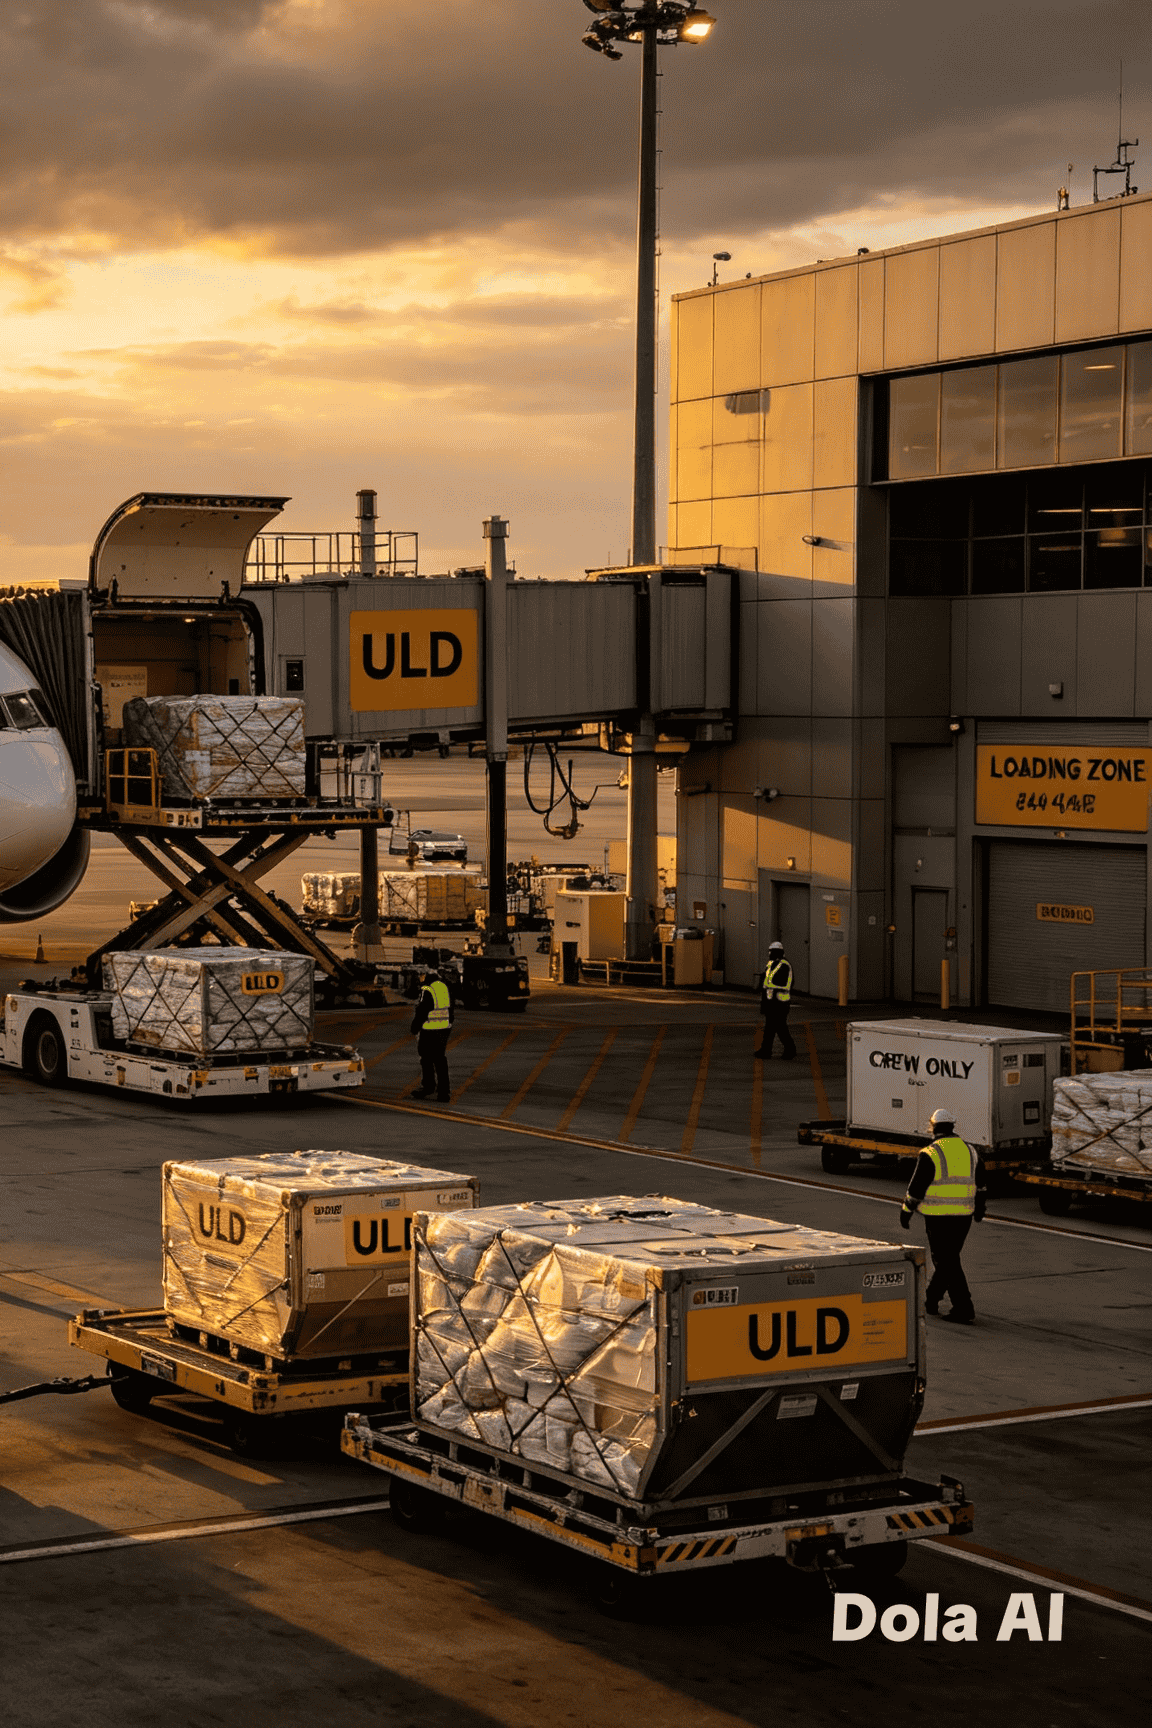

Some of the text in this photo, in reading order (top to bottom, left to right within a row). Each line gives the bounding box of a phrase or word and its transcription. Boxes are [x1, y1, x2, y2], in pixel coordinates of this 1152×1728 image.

[362, 631, 463, 680] ULD
[990, 755, 1147, 783] LOADING ZONE
[925, 1057, 975, 1080] ONLY
[199, 1202, 247, 1246] ULD
[748, 1306, 850, 1362] ULD
